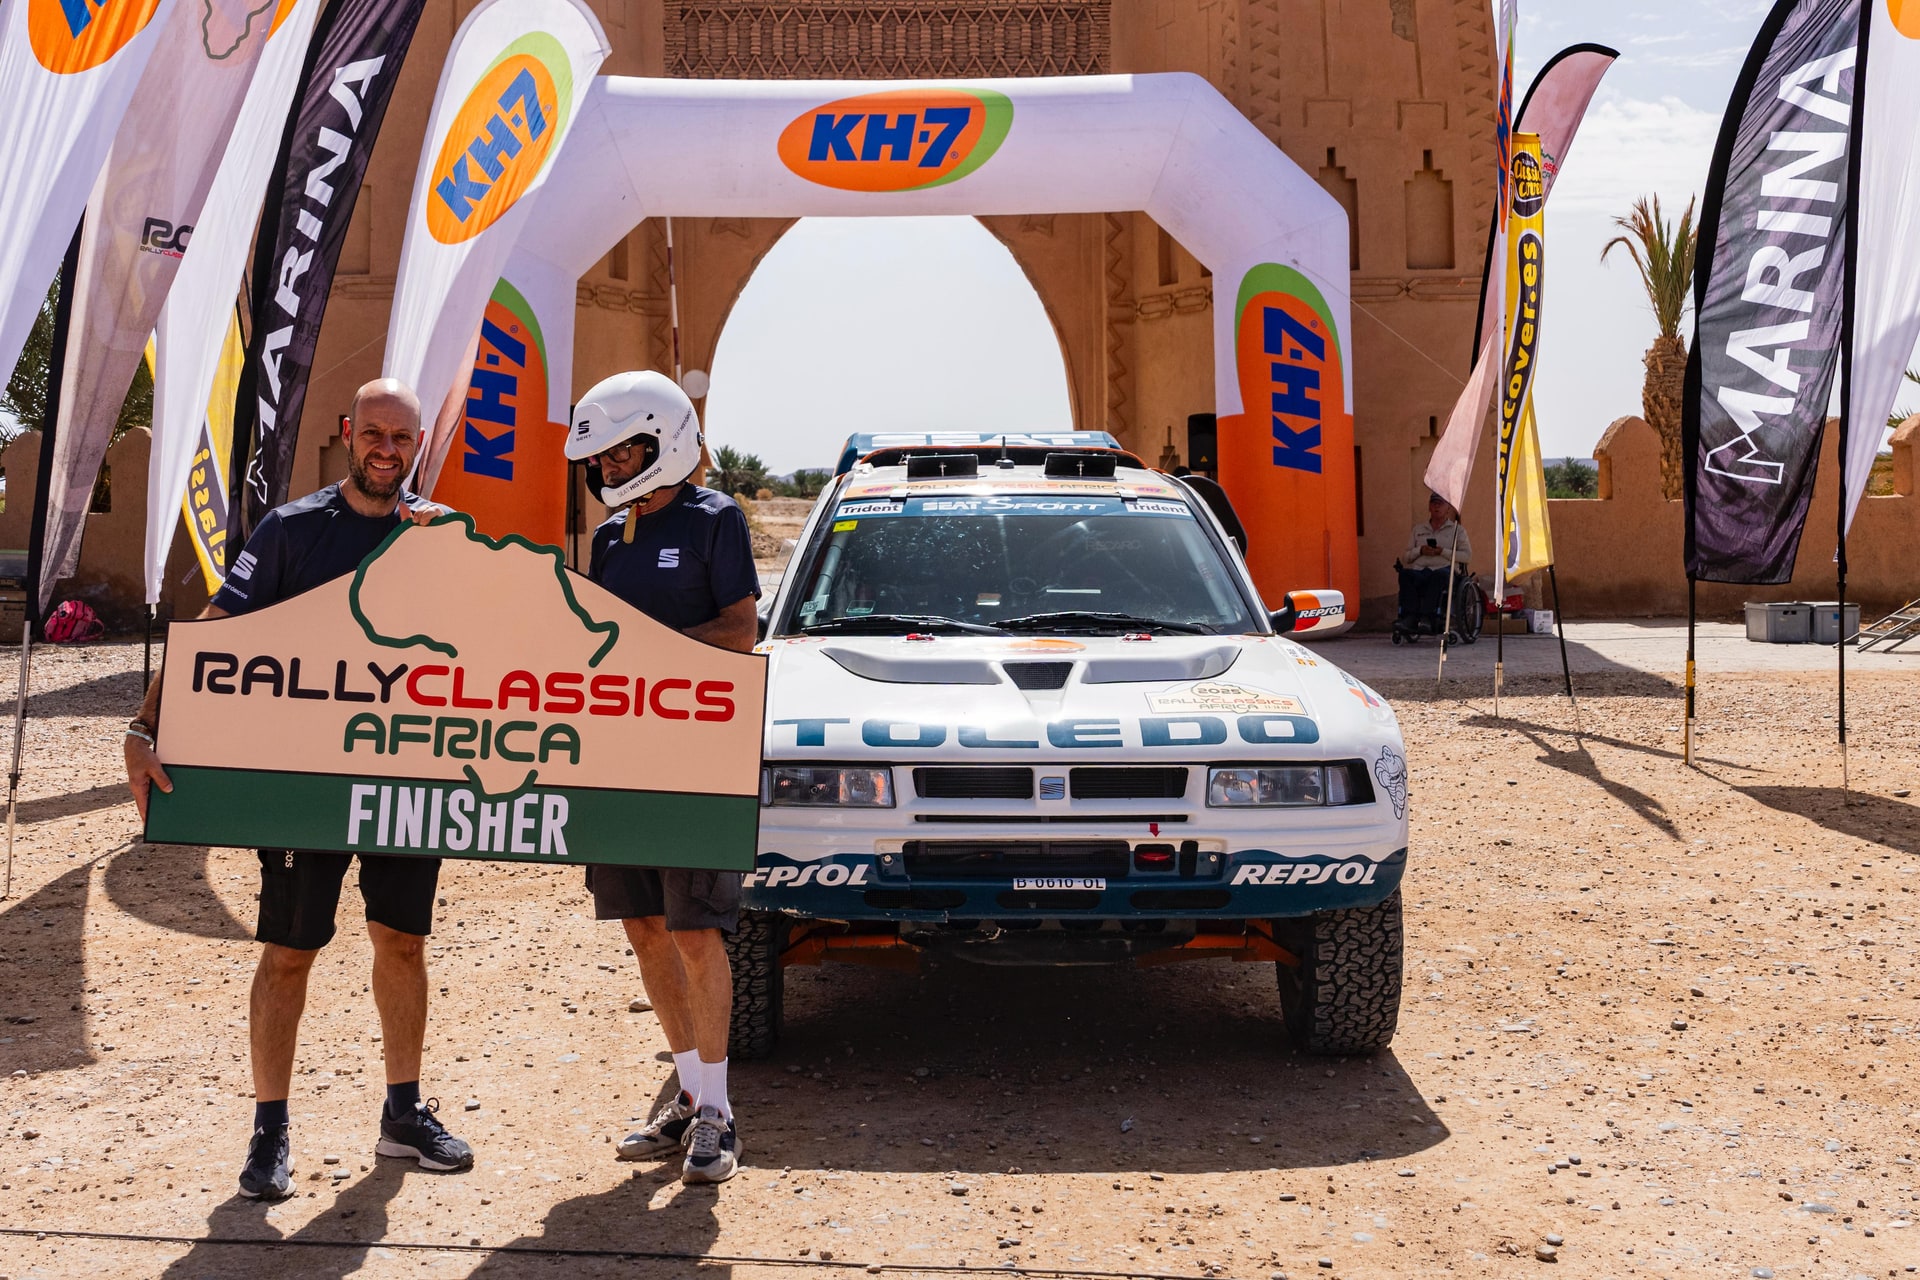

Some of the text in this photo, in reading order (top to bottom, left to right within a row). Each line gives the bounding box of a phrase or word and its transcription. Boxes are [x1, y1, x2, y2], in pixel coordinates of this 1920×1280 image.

[808, 107, 971, 168] KH-7
[246, 54, 387, 505] MARINA
[1704, 44, 1857, 484] MARINA
[1263, 306, 1325, 474] KH-7
[842, 504, 899, 515] Trident
[922, 500, 981, 511] SEAT
[1131, 502, 1187, 514] Trident
[1299, 606, 1343, 618] REPSOL
[192, 651, 736, 722] RALLYCLASSICS
[1158, 697, 1294, 706] RALLYCLASSICS
[1197, 687, 1241, 695] 2025
[343, 712, 581, 766] AFRICA
[773, 714, 1320, 749] TOLEDO
[347, 783, 570, 856] FINISHER
[1230, 862, 1378, 885] REPSOL
